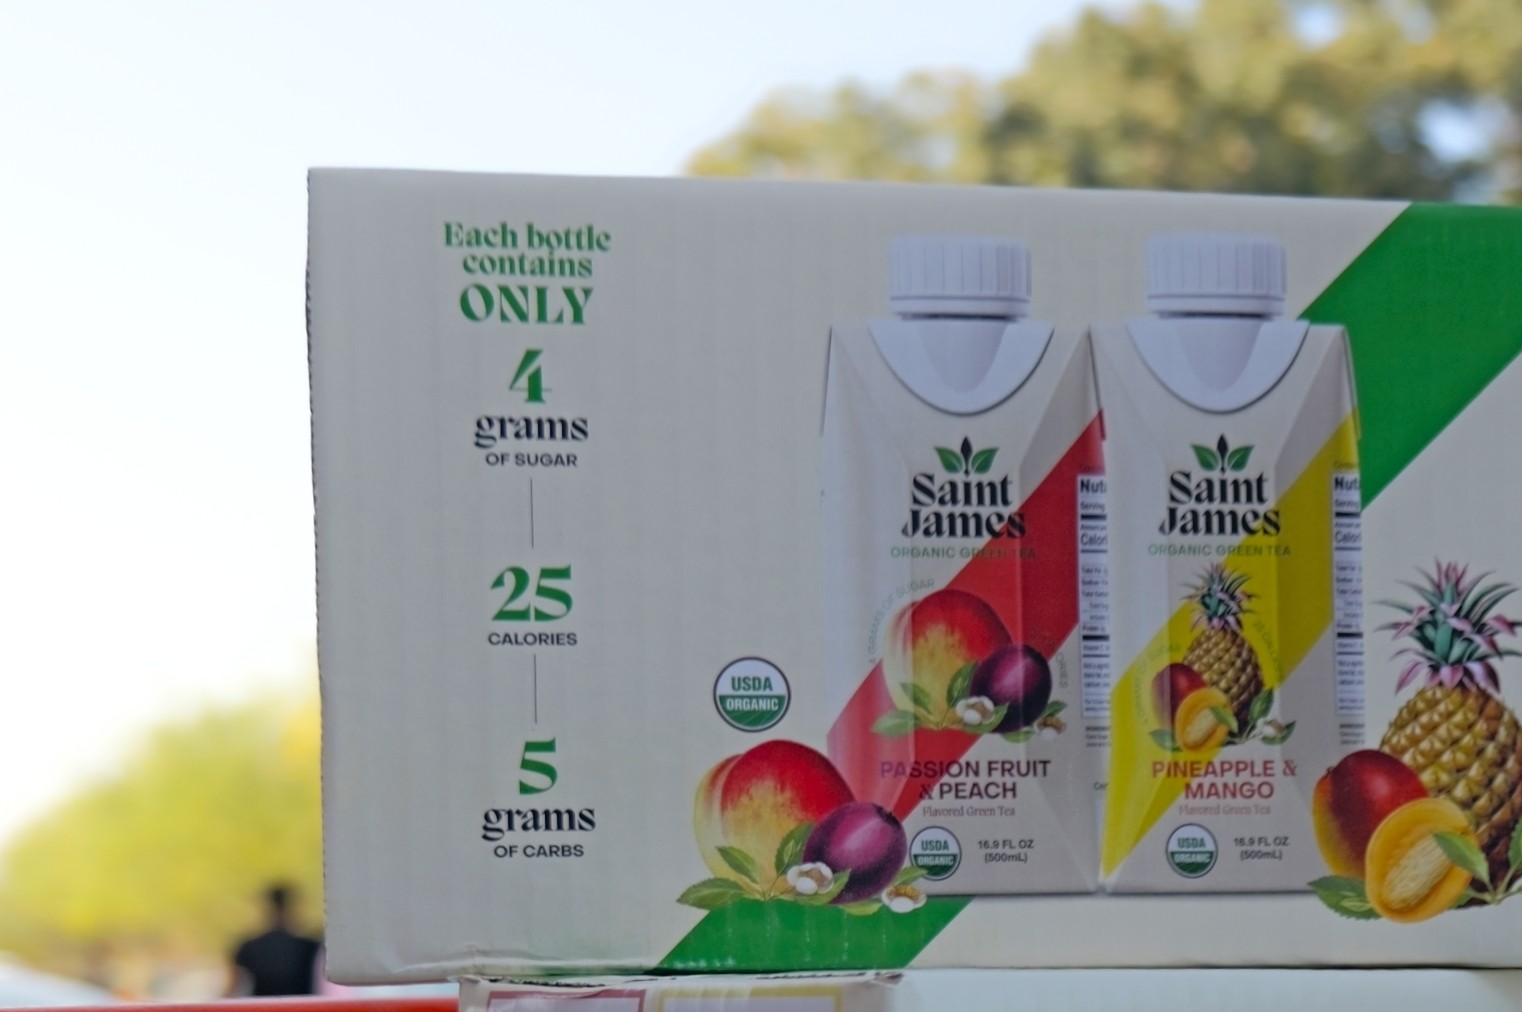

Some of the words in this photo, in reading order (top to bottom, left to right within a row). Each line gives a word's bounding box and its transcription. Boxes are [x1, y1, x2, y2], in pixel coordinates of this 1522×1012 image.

[444, 222, 519, 250] Each
[527, 223, 611, 253] bottle
[463, 250, 593, 277] contains
[460, 283, 594, 325] ONLY
[508, 349, 552, 402] 4
[473, 415, 589, 449] grams
[486, 453, 509, 467] OF
[514, 453, 577, 467] SUGAR
[911, 473, 1012, 507] Saint
[1168, 471, 1269, 505] Saint
[901, 509, 1026, 539] James
[1158, 507, 1281, 536] James
[891, 547, 955, 559] ORGANIC
[1147, 544, 1212, 557] ORGANIC
[1216, 544, 1263, 557] GREEN
[1266, 544, 1291, 557] TEA
[490, 564, 573, 621] 25
[488, 632, 577, 646] CALORIES
[730, 675, 773, 692] USDA
[726, 697, 779, 712] ORGANIC
[518, 738, 557, 795] 5
[880, 760, 980, 778] PASSION
[988, 760, 1052, 777] FRUIT
[1152, 760, 1275, 778] PINEAPPLE
[1282, 761, 1298, 777] &
[919, 783, 934, 800] &
[939, 782, 1017, 799] PEACH
[1184, 781, 1274, 800] MANGO
[922, 806, 964, 817] Flavored
[966, 806, 995, 817] Green
[997, 806, 1016, 817] Tea
[481, 807, 596, 841] grams
[921, 840, 949, 851] USDA
[978, 840, 999, 849] 16.9
[1002, 840, 1016, 849] FL
[1019, 840, 1034, 849] OZ
[1178, 838, 1206, 849] USDA
[1258, 837, 1271, 847] FL
[1274, 837, 1289, 847] OZ
[494, 845, 519, 858] OF
[524, 845, 584, 858] CARBS
[984, 853, 1028, 863] (500mL)
[1174, 854, 1211, 864] ORGANIC
[1240, 849, 1282, 861] (500mL)
[918, 856, 954, 866] ORGANIC
